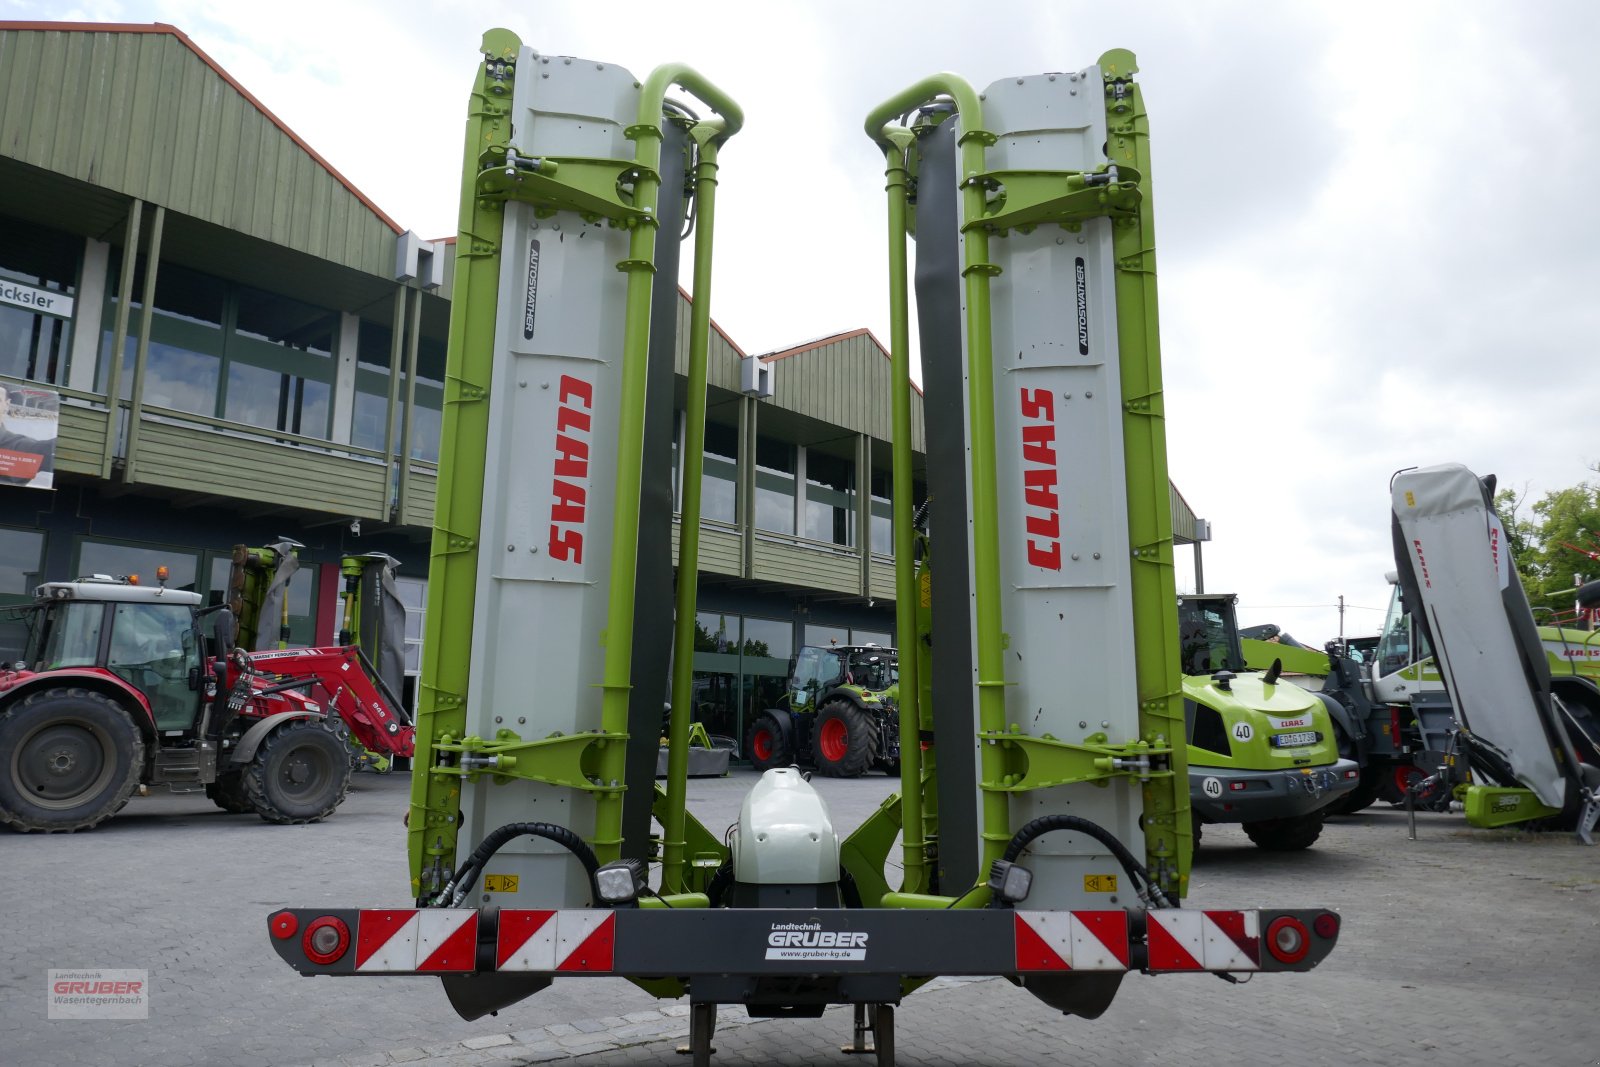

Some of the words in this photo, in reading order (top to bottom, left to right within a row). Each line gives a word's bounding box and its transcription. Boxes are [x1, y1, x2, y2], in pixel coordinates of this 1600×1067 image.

[525, 248, 539, 332] AUTOSWATHER
[1076, 265, 1088, 347] AUTOSWATHER
[548, 374, 593, 565] CLAAS
[1020, 387, 1062, 571] CLAAS
[1280, 719, 1304, 728] CLAAS
[1236, 725, 1250, 738] 40
[1206, 780, 1219, 794] 40
[771, 922, 822, 931] Landtechnik
[768, 931, 869, 947] GRUBER
[780, 950, 851, 958] www.gruber-kg.de
